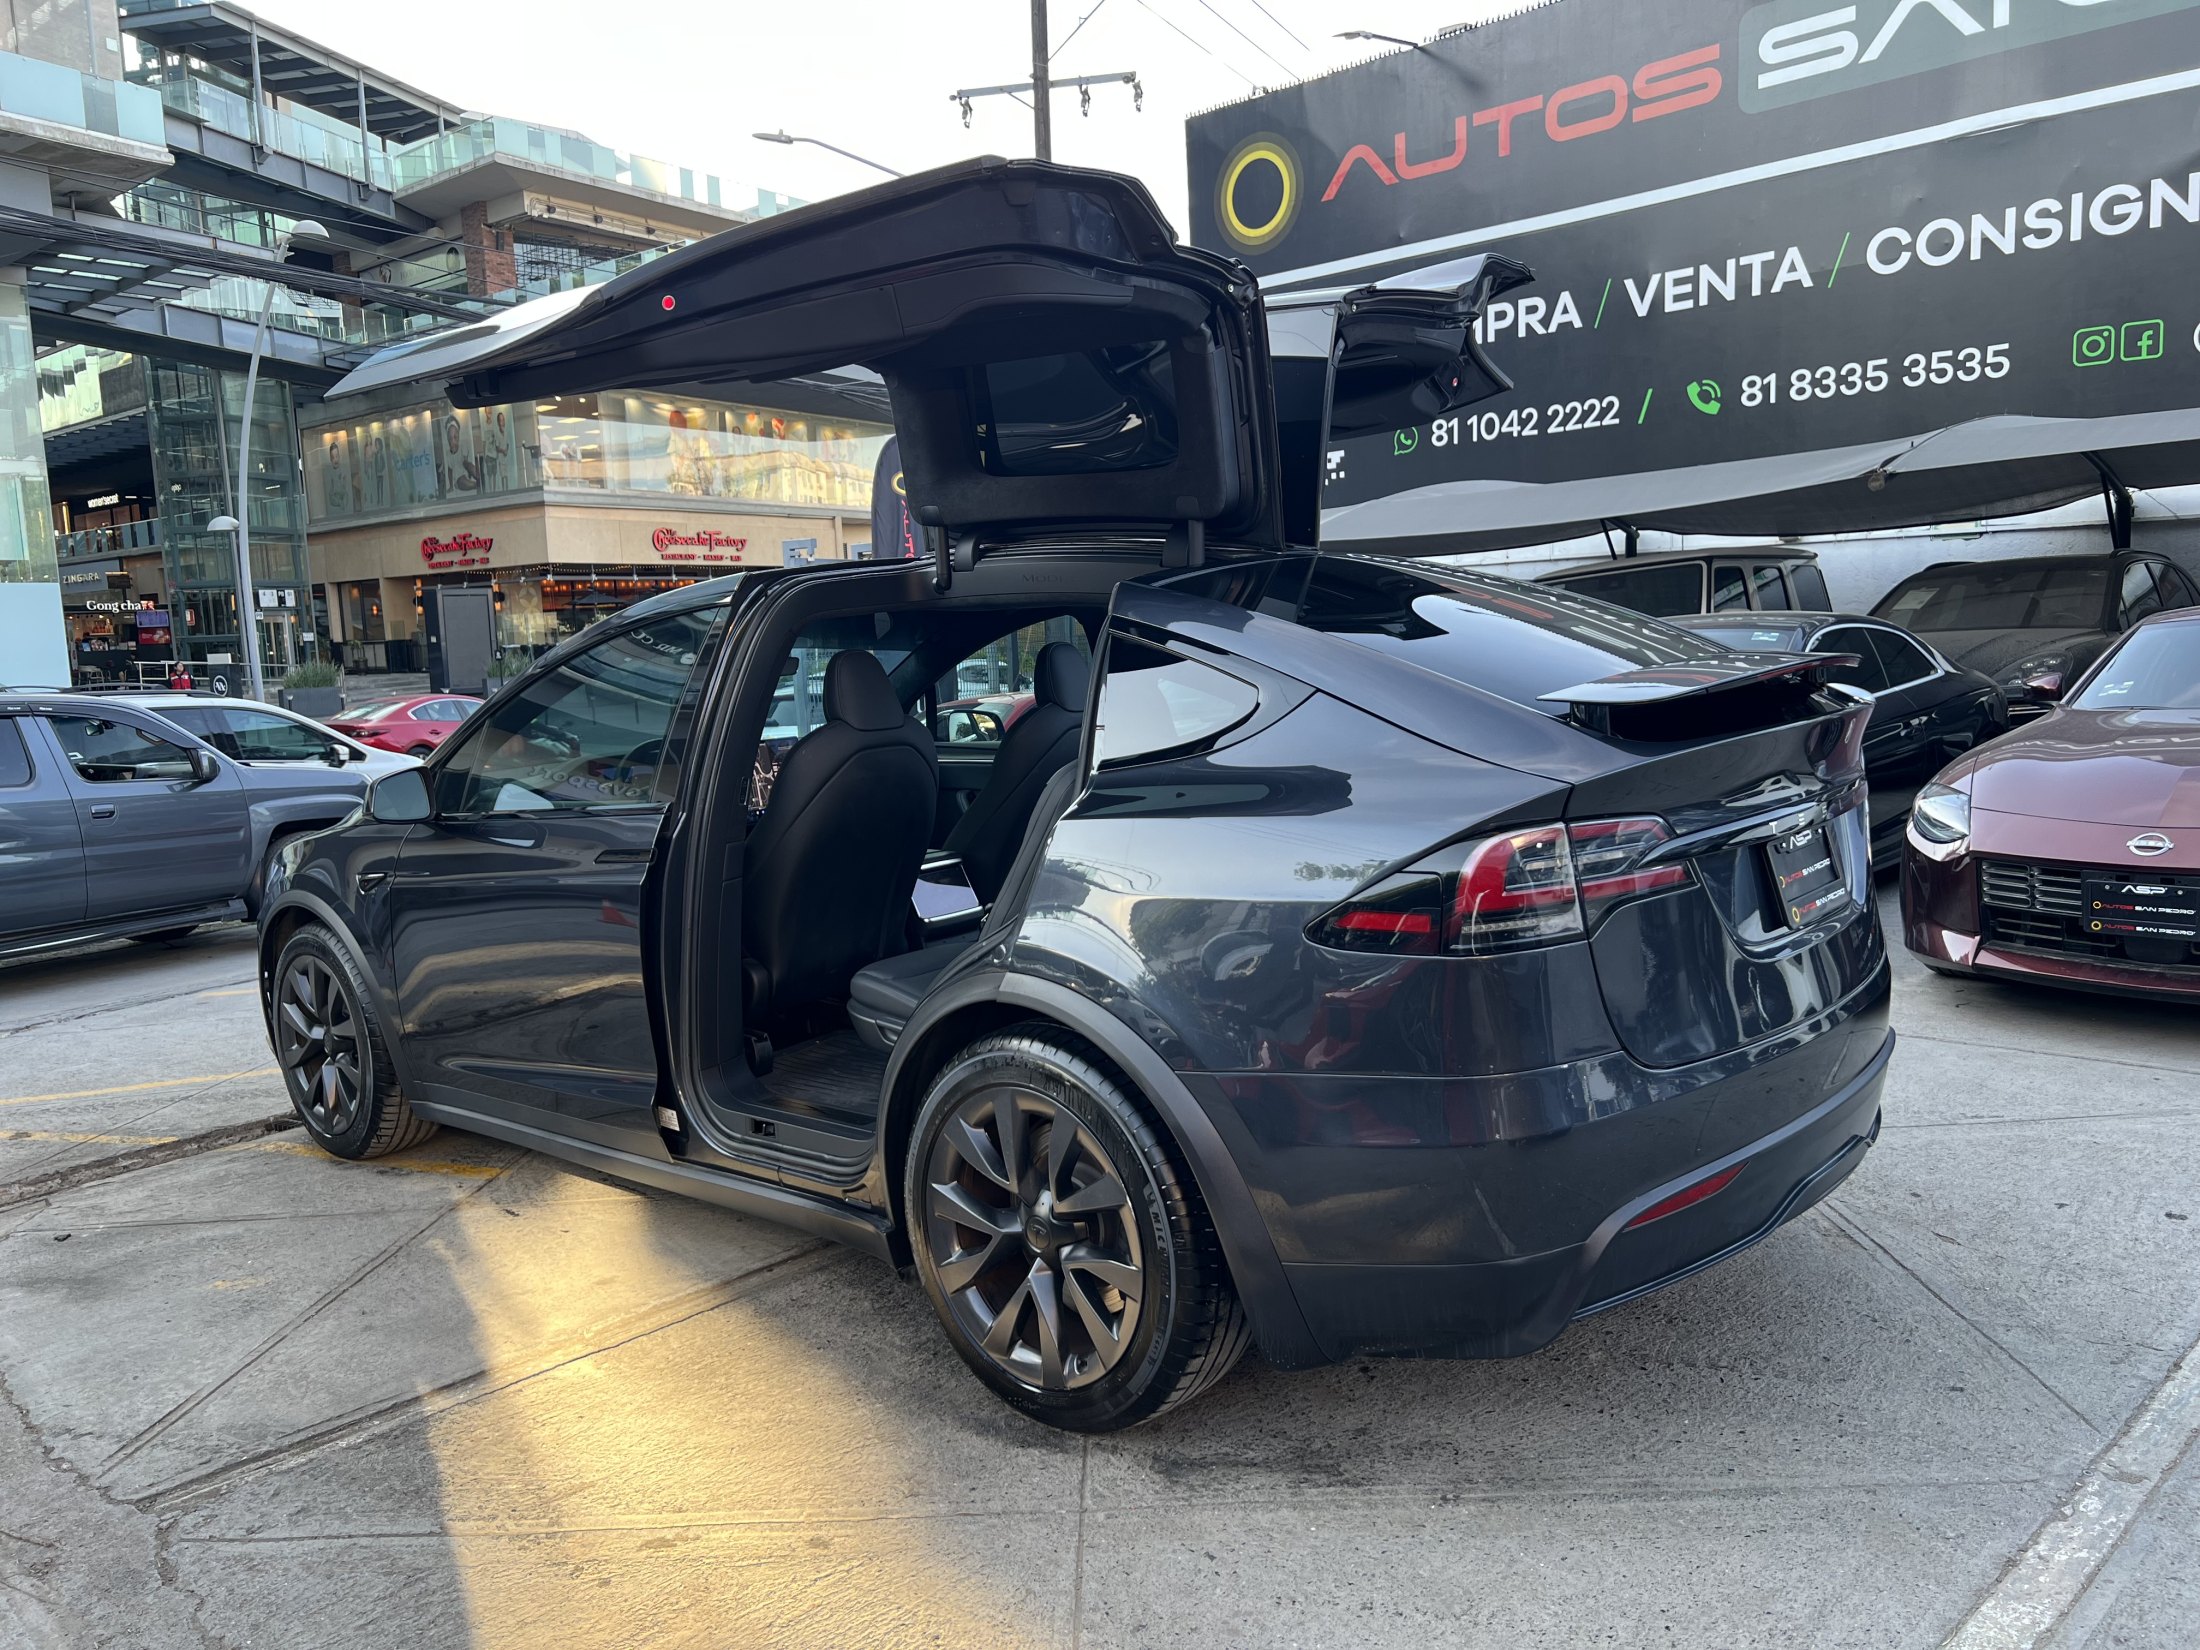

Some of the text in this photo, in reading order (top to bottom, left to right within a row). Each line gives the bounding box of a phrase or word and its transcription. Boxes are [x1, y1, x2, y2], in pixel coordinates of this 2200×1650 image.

[1321, 0, 2107, 202] AUTOS SA
[1472, 289, 1583, 345] PRA
[1623, 245, 1813, 318] VENTA
[1866, 171, 2200, 275] CONSIGN
[1431, 418, 1459, 447] 81
[1466, 411, 1539, 442] 1042
[1546, 395, 1620, 434] 2222
[1740, 372, 1777, 407] 81
[1789, 358, 1889, 401] 8335
[1902, 342, 2011, 387] 3535
[703, 531, 747, 552] Factory
[63, 572, 100, 584] ZINGARA
[86, 600, 119, 613] Gong
[121, 600, 141, 610] cha
[1790, 829, 1812, 849] ASP
[1802, 865, 1815, 876] SAN
[1816, 896, 1829, 907] SAN
[2158, 907, 2196, 915] PEDRO
